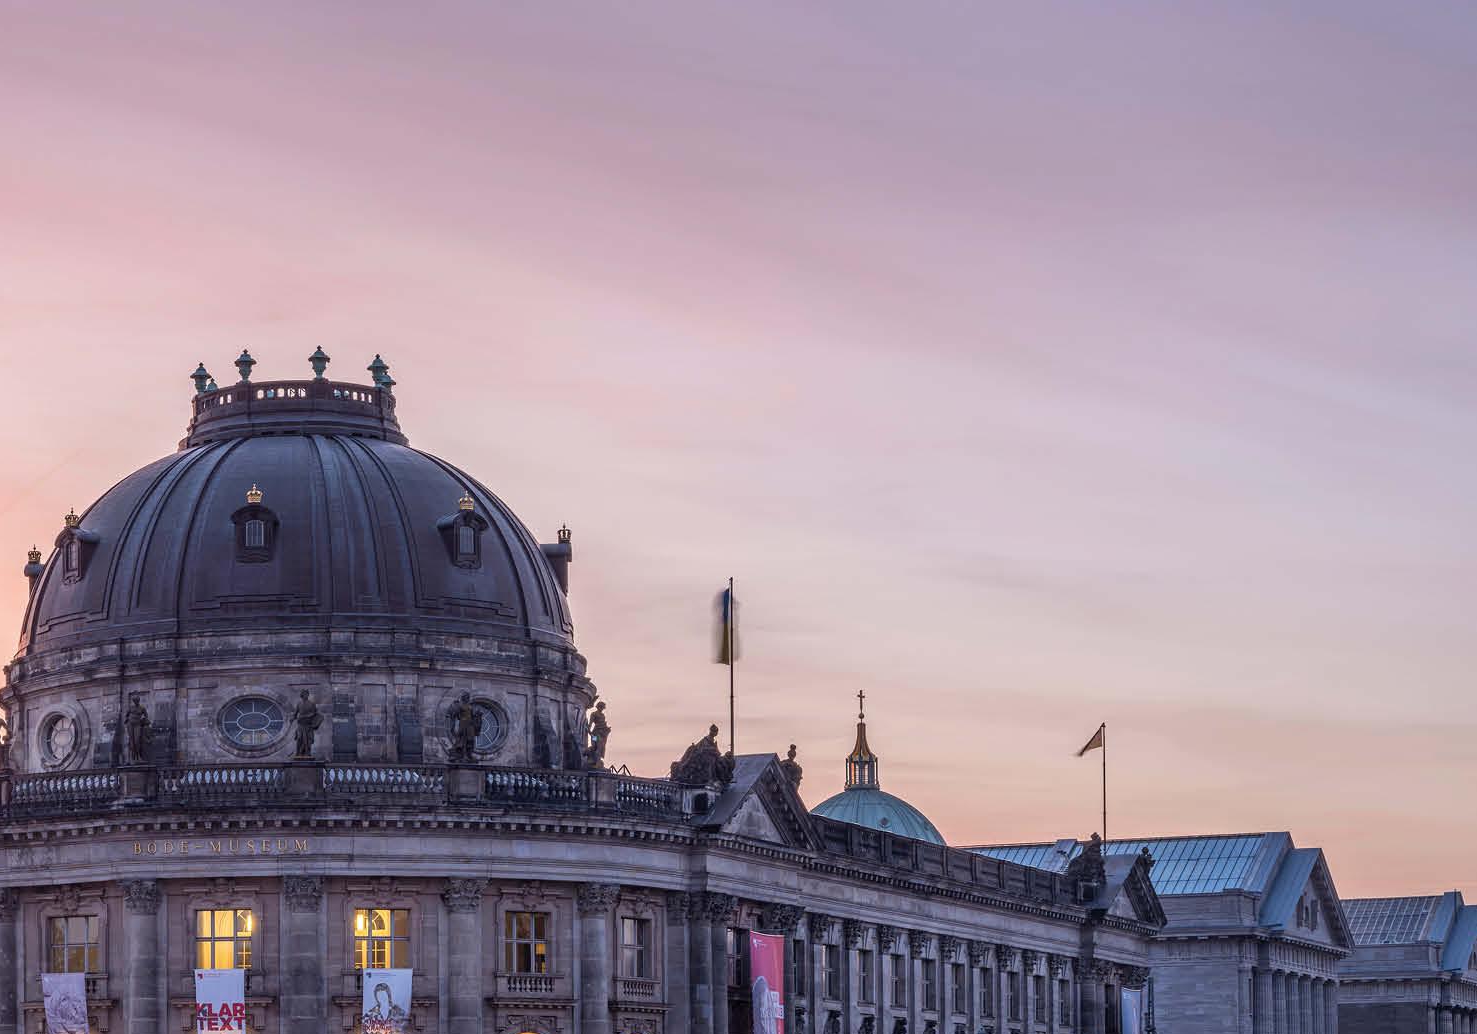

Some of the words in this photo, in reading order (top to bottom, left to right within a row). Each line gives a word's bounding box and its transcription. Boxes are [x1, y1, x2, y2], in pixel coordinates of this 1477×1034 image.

[133, 839, 309, 856] BODE-MUSEUM
[196, 1002, 245, 1017] KLAR
[197, 1016, 246, 1031] TEXT
